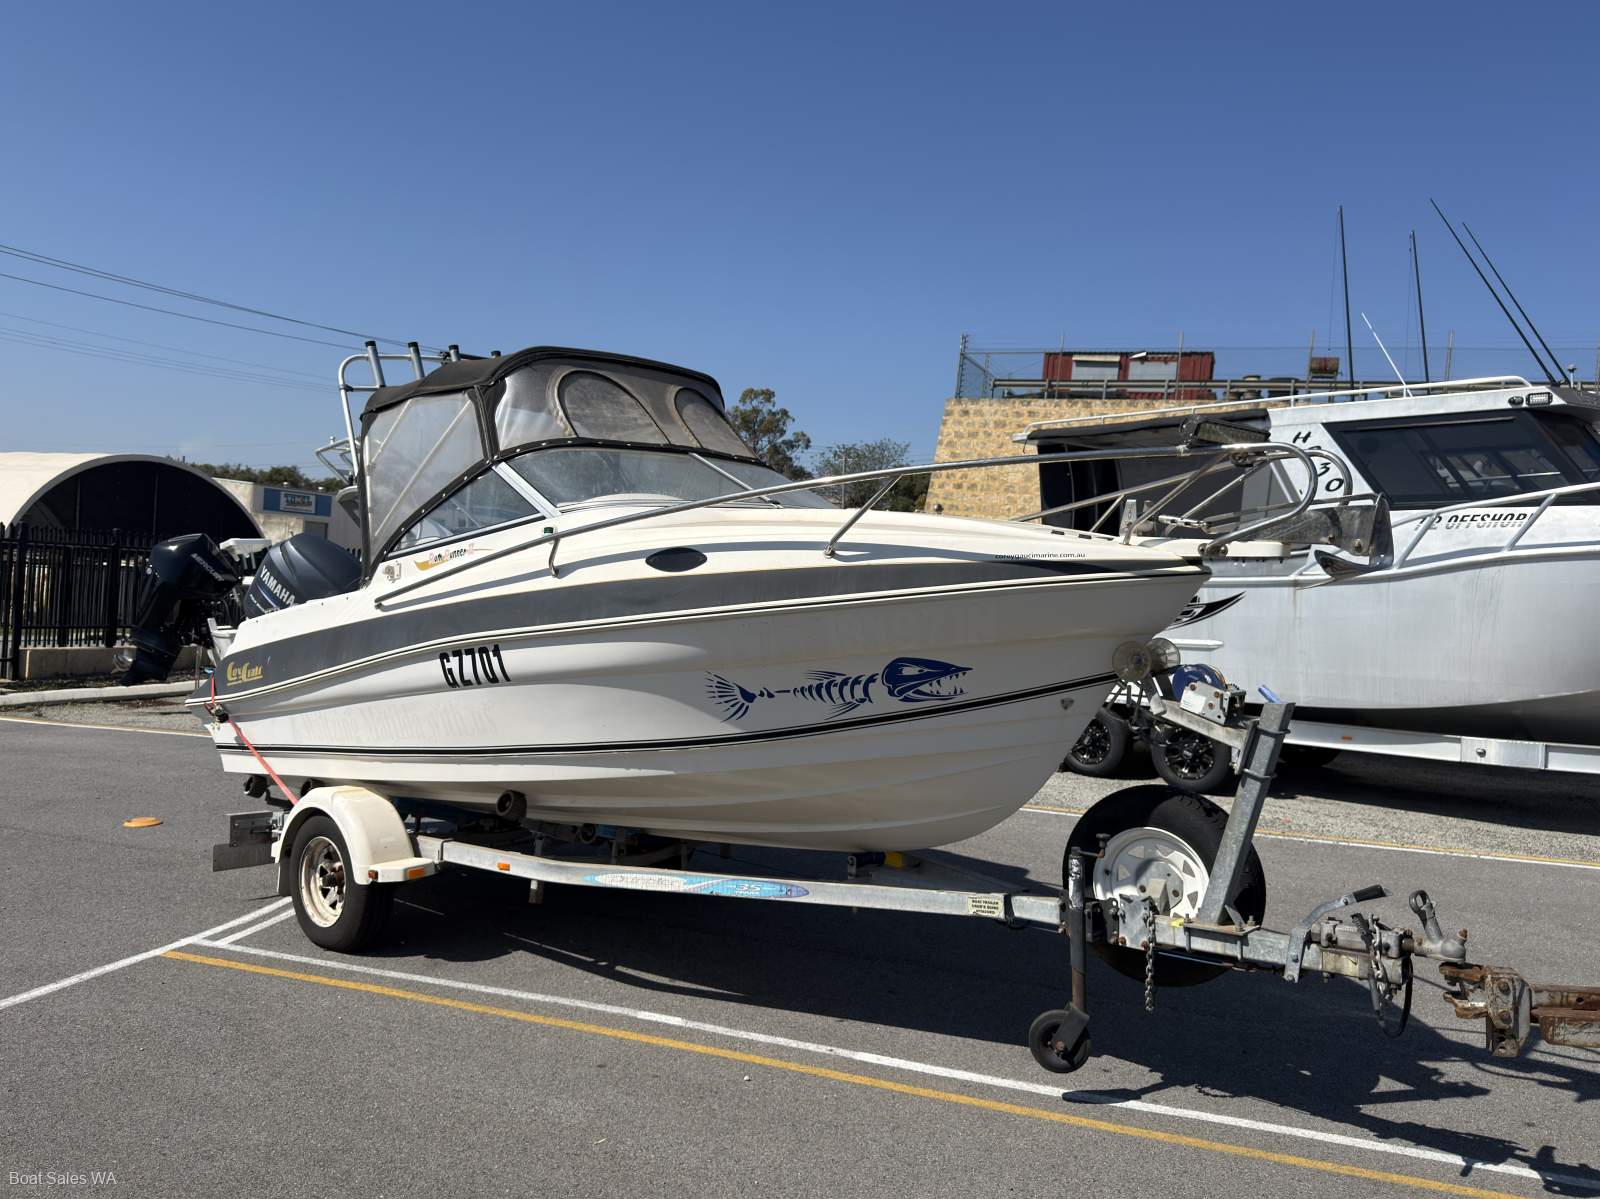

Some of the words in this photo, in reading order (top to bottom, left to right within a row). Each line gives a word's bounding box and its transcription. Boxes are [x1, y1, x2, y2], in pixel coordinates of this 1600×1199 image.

[1446, 512, 1533, 530] OFFSHOR
[260, 565, 296, 607] YAMAHA
[439, 643, 512, 688] GZ701
